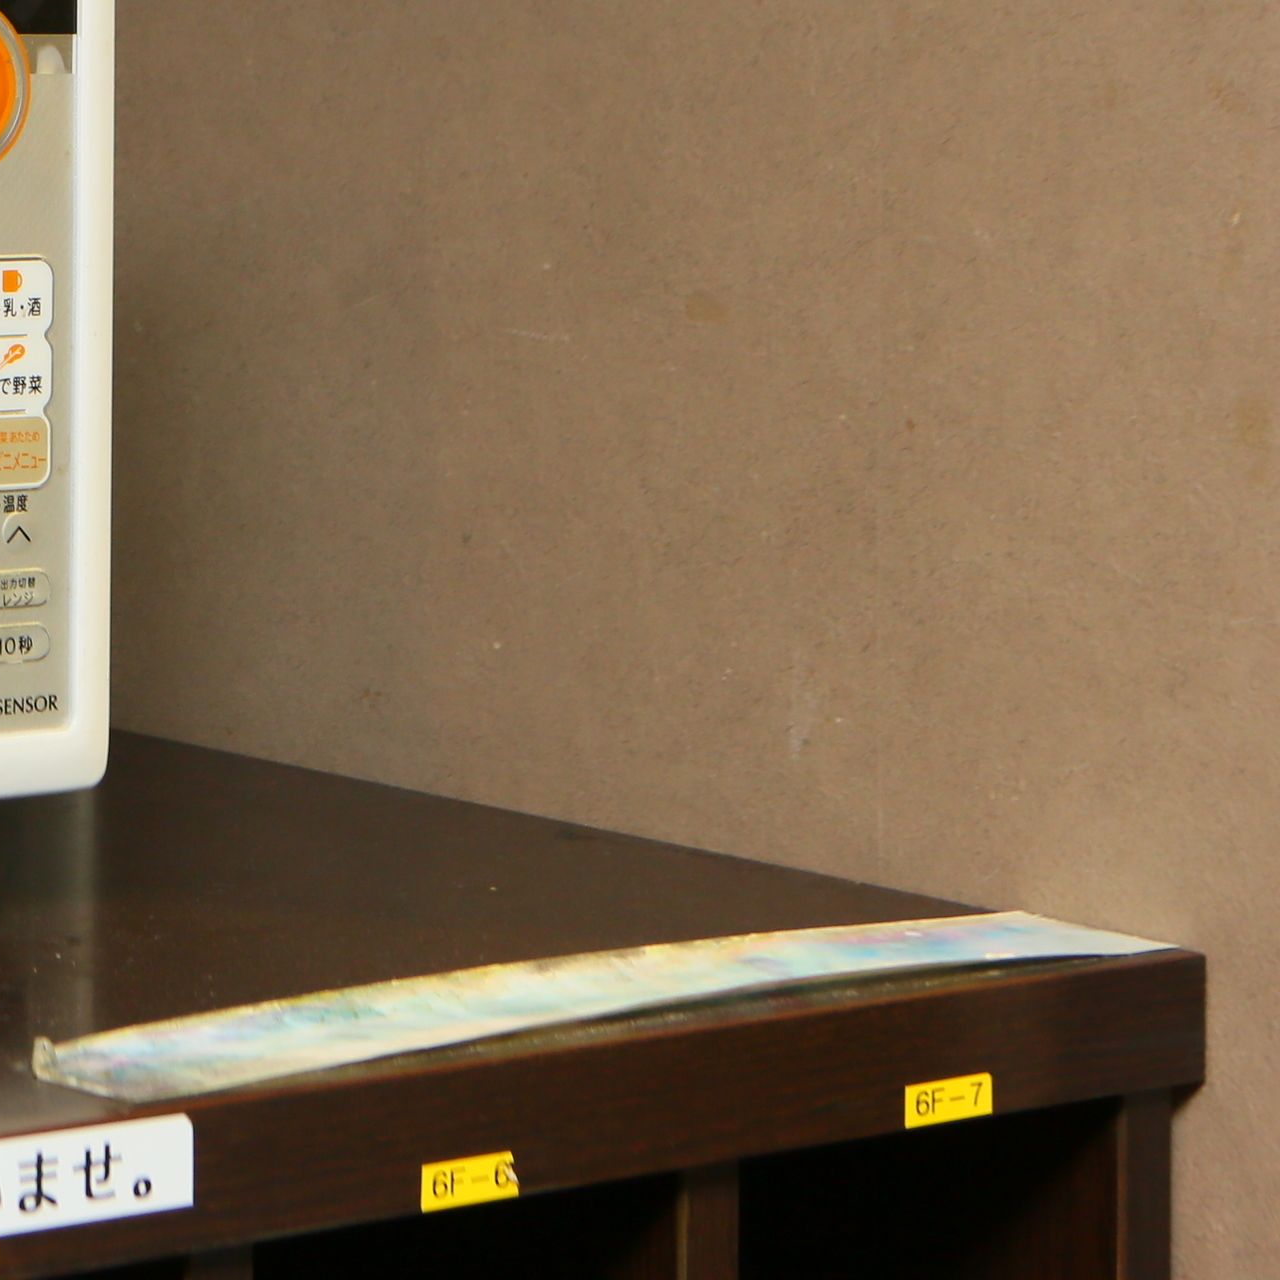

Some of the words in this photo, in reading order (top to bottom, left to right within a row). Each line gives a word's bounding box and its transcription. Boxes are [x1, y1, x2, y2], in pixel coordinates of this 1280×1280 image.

[2, 590, 34, 607] レンジ
[915, 1082, 983, 1117] 6F-7
